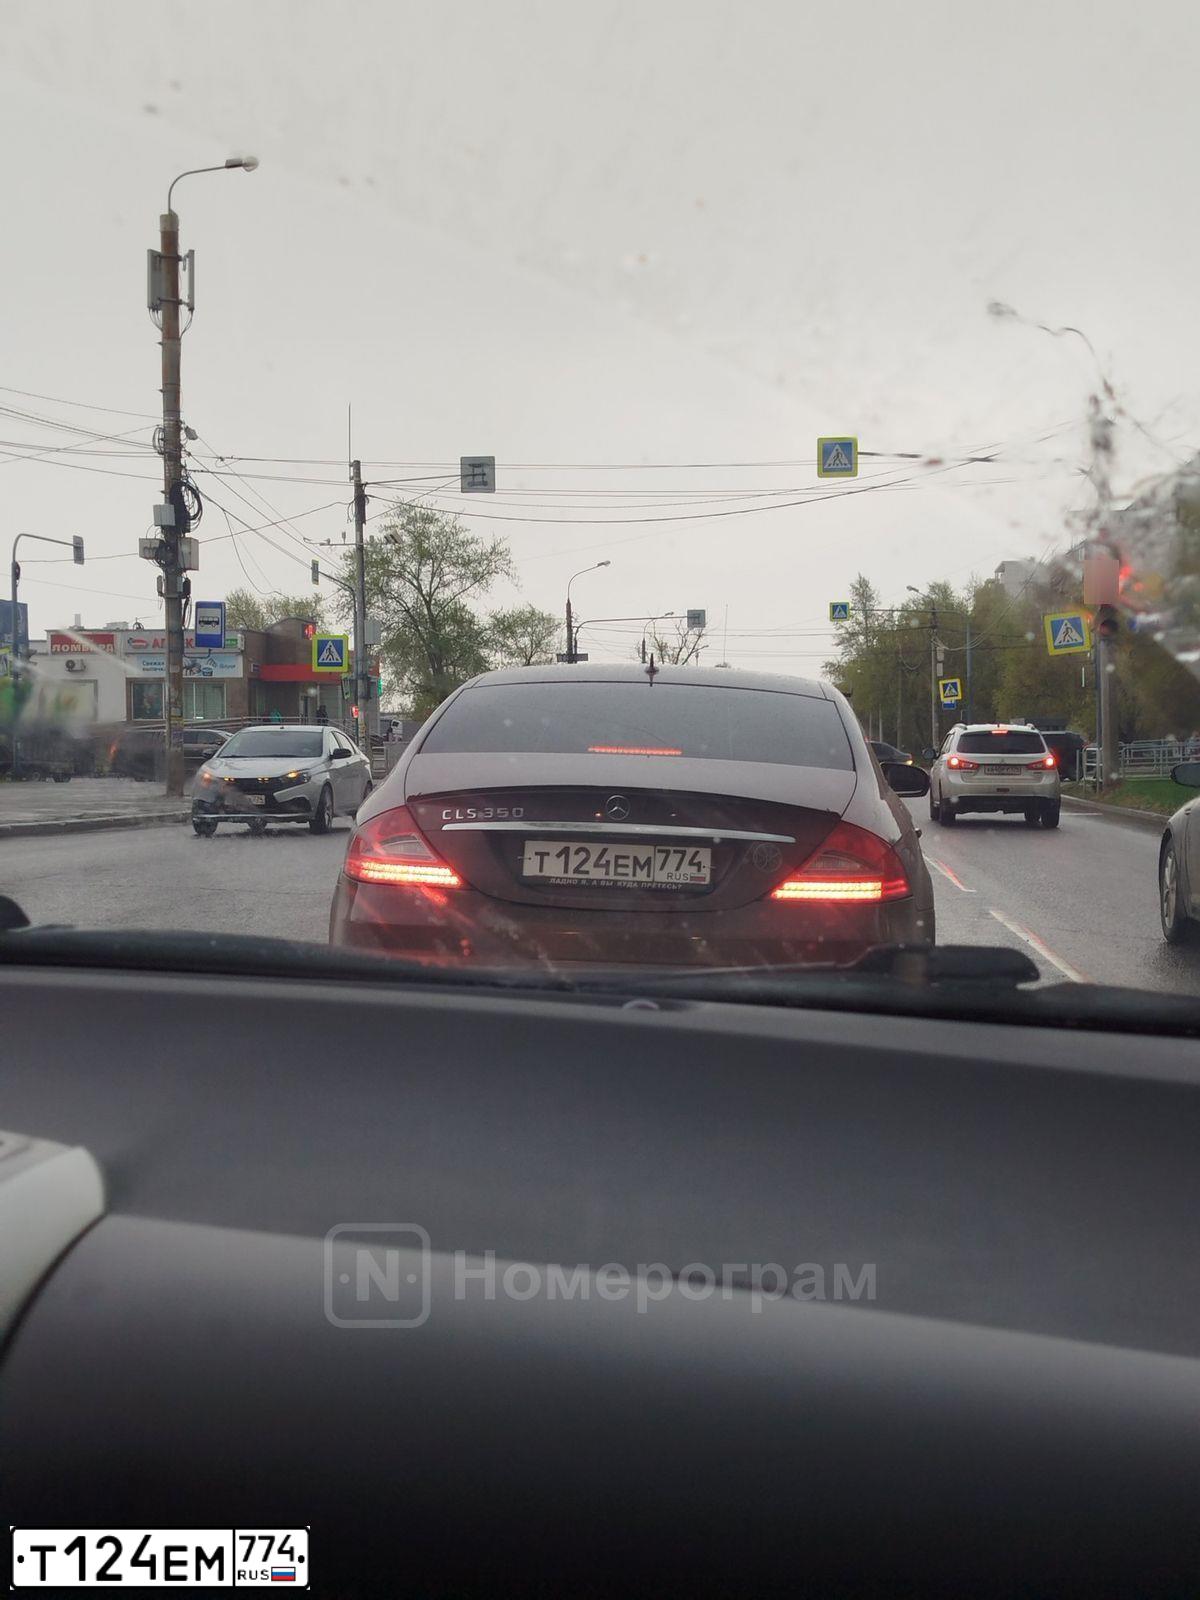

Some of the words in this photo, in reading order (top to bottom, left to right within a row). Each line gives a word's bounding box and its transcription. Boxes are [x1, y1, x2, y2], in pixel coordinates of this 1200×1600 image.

[442, 808, 477, 820] CLS
[484, 807, 524, 818] 350
[534, 846, 652, 878] Т124ЕМ
[657, 849, 703, 873] 774
[667, 872, 689, 881] RUS
